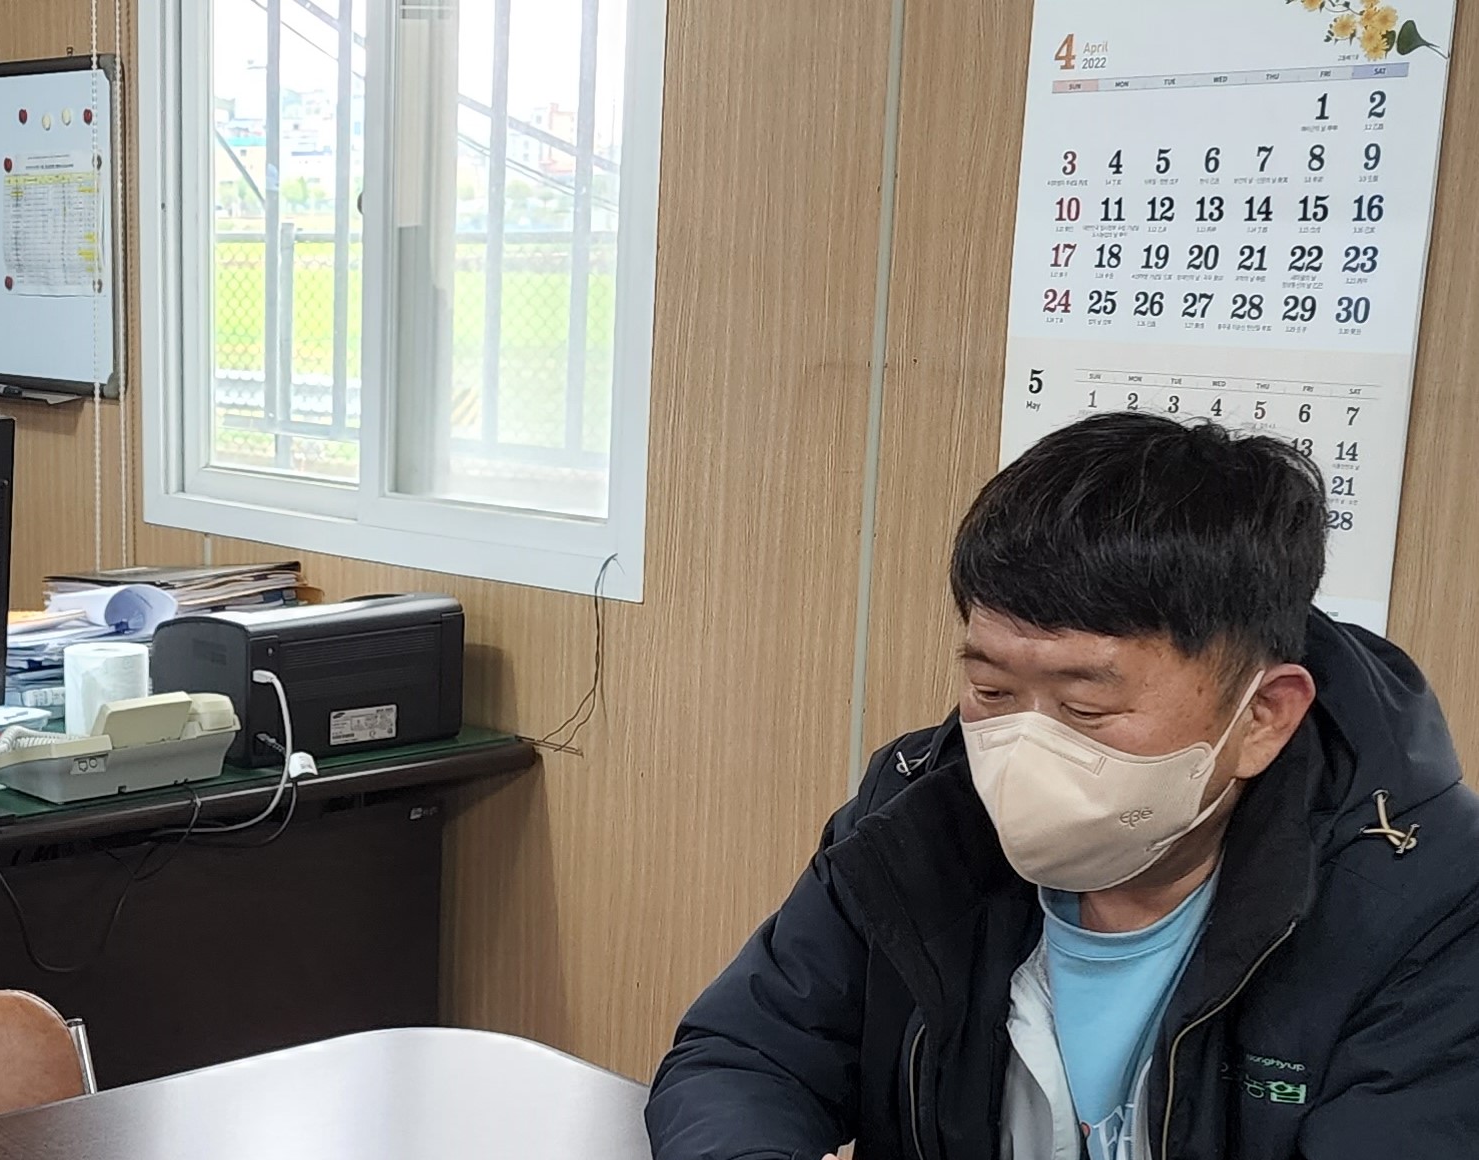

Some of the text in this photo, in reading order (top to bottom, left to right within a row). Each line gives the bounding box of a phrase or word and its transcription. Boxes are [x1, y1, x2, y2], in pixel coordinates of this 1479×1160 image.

[1054, 33, 1076, 70] 4
[1083, 41, 1108, 55] April
[1082, 57, 1107, 69] 2022
[1315, 90, 1387, 120] 1 2
[1062, 143, 1381, 176] 3 4 5 6 7 8 9
[1054, 194, 1384, 222] 10 11 12 13 14 15 16
[1049, 243, 1379, 274] 17 18 19 20 21 22 23
[1042, 288, 1371, 324] 24 25 26 27 28 29 30
[1028, 369, 1044, 394] 5
[1026, 401, 1041, 412] May
[1088, 390, 1360, 426] 1 2 3 4 5 6 7
[1291, 438, 1358, 461] 13 14
[1330, 475, 1355, 496] 21
[1326, 510, 1353, 530] 28
